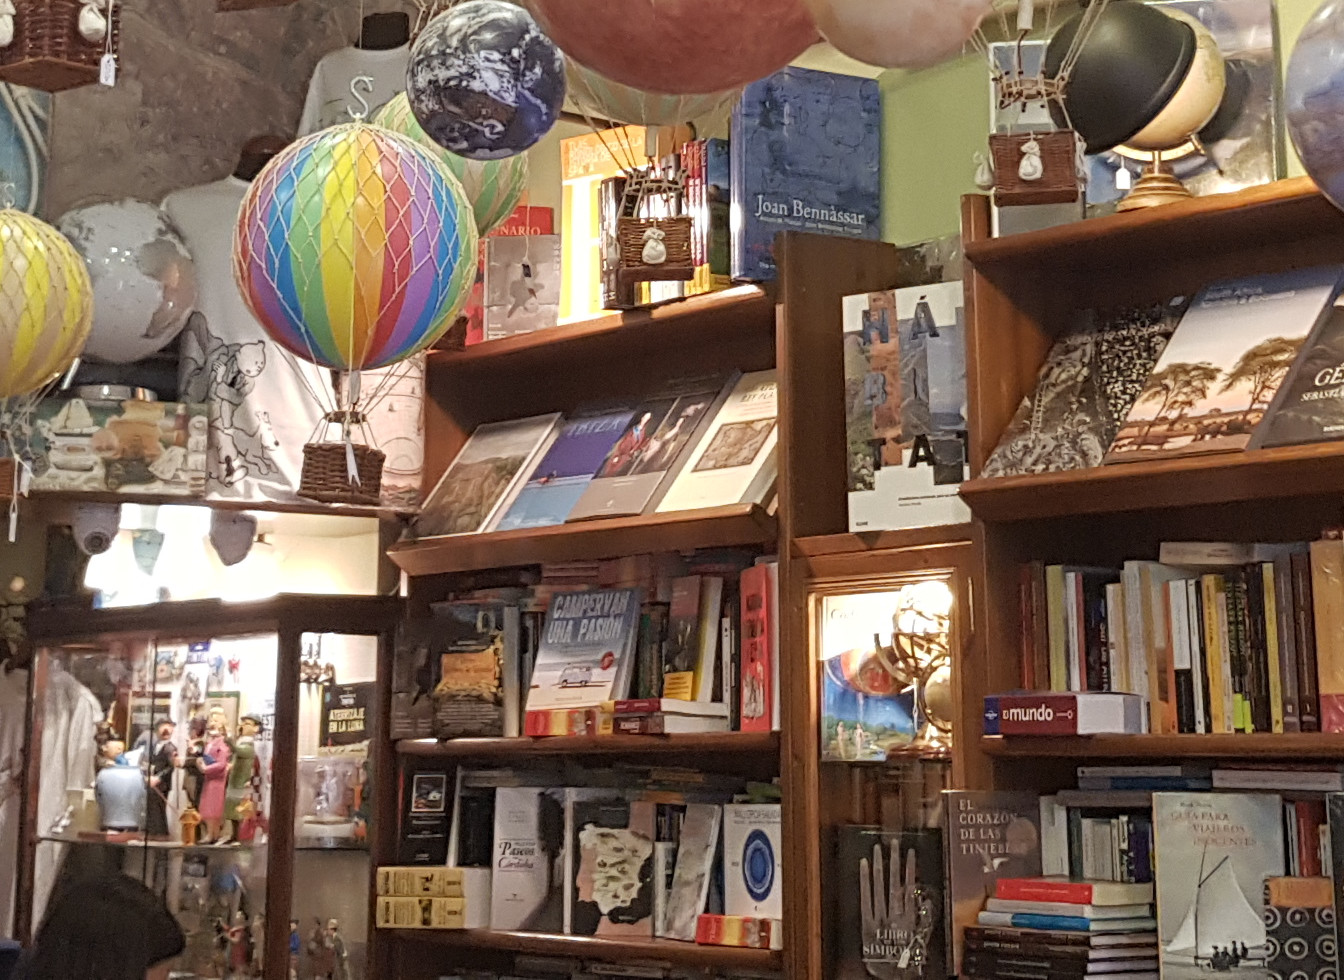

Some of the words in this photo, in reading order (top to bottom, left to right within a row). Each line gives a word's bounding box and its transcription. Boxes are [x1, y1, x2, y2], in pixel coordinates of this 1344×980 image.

[755, 194, 788, 217] Joan
[792, 199, 865, 226] Bennàssar
[553, 591, 630, 619] CAMPERVAN
[548, 620, 573, 643] UNA
[1009, 703, 1054, 722] mundo
[959, 799, 974, 811] EL
[960, 828, 975, 840] DE
[980, 827, 1001, 839] LAS
